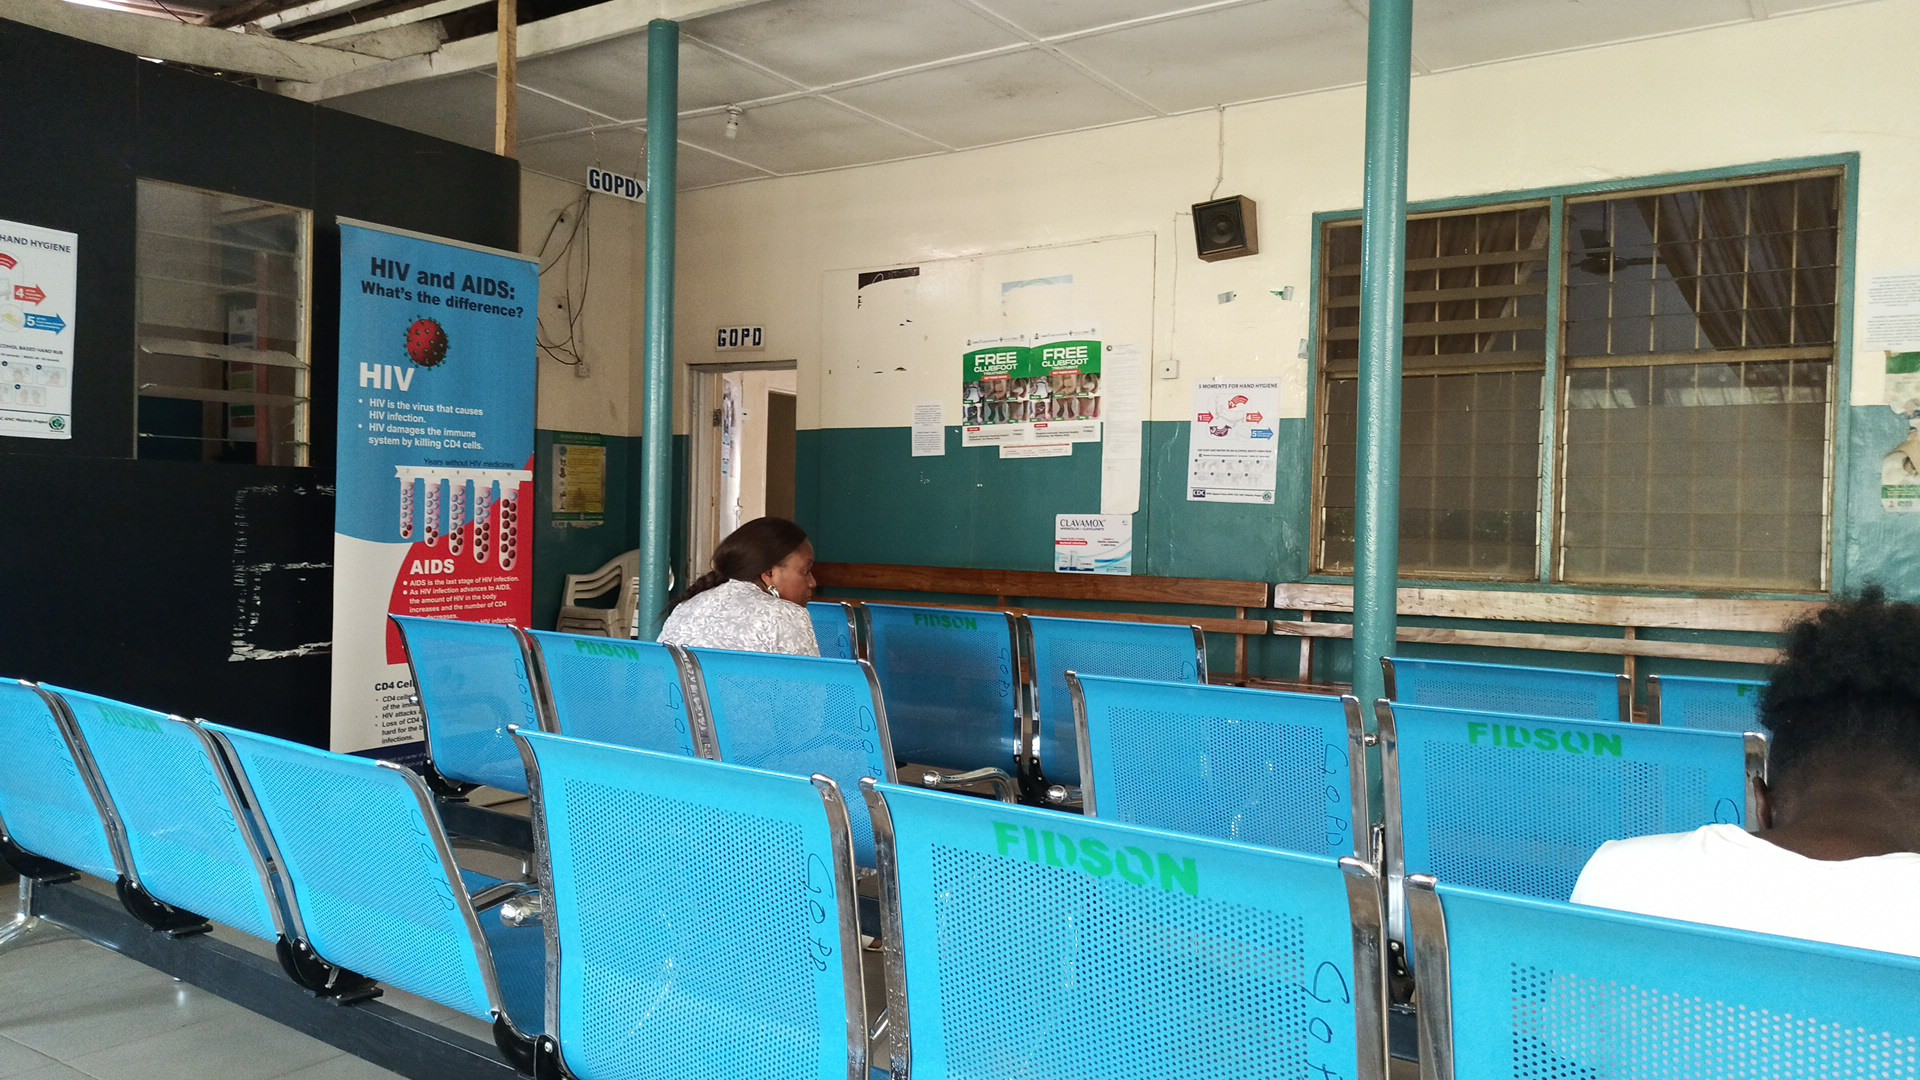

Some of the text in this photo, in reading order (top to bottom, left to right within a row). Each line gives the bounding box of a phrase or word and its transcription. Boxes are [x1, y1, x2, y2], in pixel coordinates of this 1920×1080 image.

[589, 168, 636, 198] GOPD
[0, 234, 72, 254] HAND HYGIENE
[371, 257, 515, 301] HIV and AIDS:
[15, 288, 25, 299] 4
[361, 280, 524, 318] What's the difference?
[26, 315, 36, 326] 5
[717, 327, 762, 347] GOPD
[974, 351, 1017, 367] FREE
[1042, 345, 1088, 361] FREE
[974, 363, 1018, 373] CLUBFOOT
[1041, 357, 1089, 368] CLUBFOOT
[359, 361, 415, 392] HIV
[369, 398, 484, 416] HIV is the virus that causes
[369, 410, 427, 424] HIV infection.
[368, 423, 477, 438] HIV damages the immune
[368, 436, 485, 450] system by killing CD4 cells.
[424, 458, 444, 466] Years
[446, 459, 468, 467] without
[1060, 518, 1105, 528] CLAVAMOX
[409, 558, 455, 575] AIDS
[458, 578, 474, 586] stage
[475, 576, 482, 584] of
[432, 586, 460, 594] infection
[460, 585, 488, 593] advances
[482, 593, 497, 601] body
[409, 606, 440, 614] increases
[440, 604, 453, 612] and
[464, 602, 486, 610] number
[494, 600, 507, 608] CD4
[913, 612, 978, 631] FIDSON
[374, 682, 395, 692] CD4
[394, 710, 416, 718] attacks
[666, 682, 695, 757] GOP
[382, 720, 398, 728] Loss
[406, 716, 420, 724] CD4
[382, 735, 414, 744] infections.
[856, 705, 882, 777] GOP
[1467, 722, 1623, 758] FIDSON
[992, 820, 1200, 896] FIDSON
